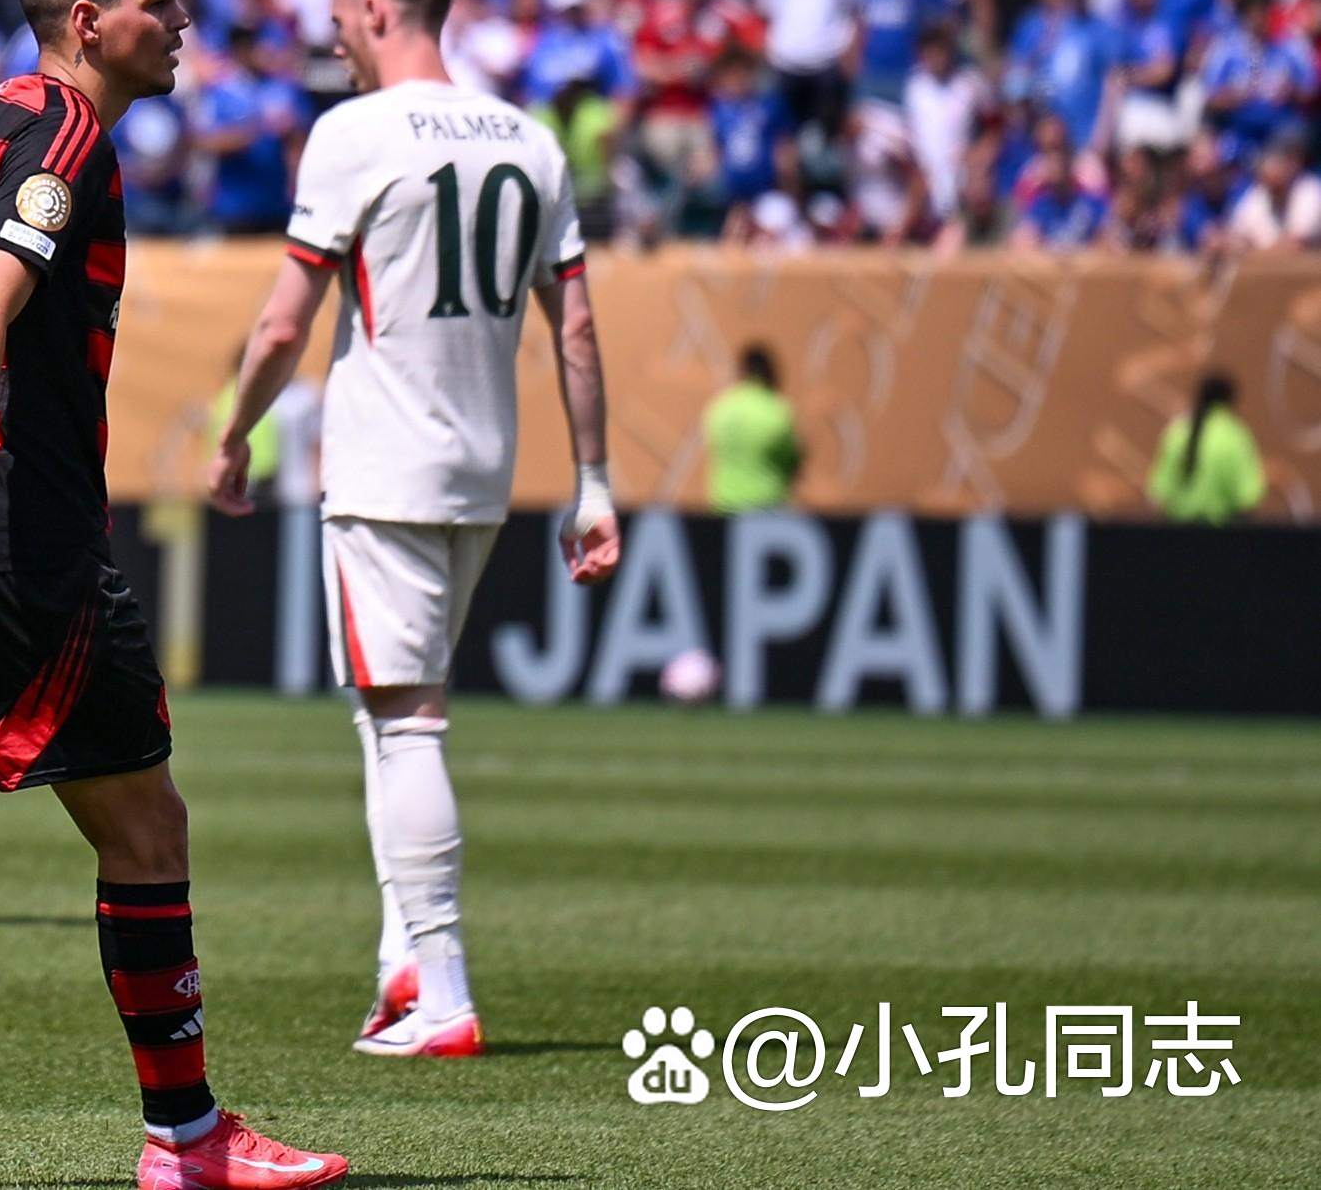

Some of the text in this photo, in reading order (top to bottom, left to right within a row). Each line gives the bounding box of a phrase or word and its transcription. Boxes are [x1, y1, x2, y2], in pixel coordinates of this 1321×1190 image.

[407, 112, 526, 143] PALMER
[427, 162, 540, 318] 10
[492, 506, 1085, 717] JAPAN
